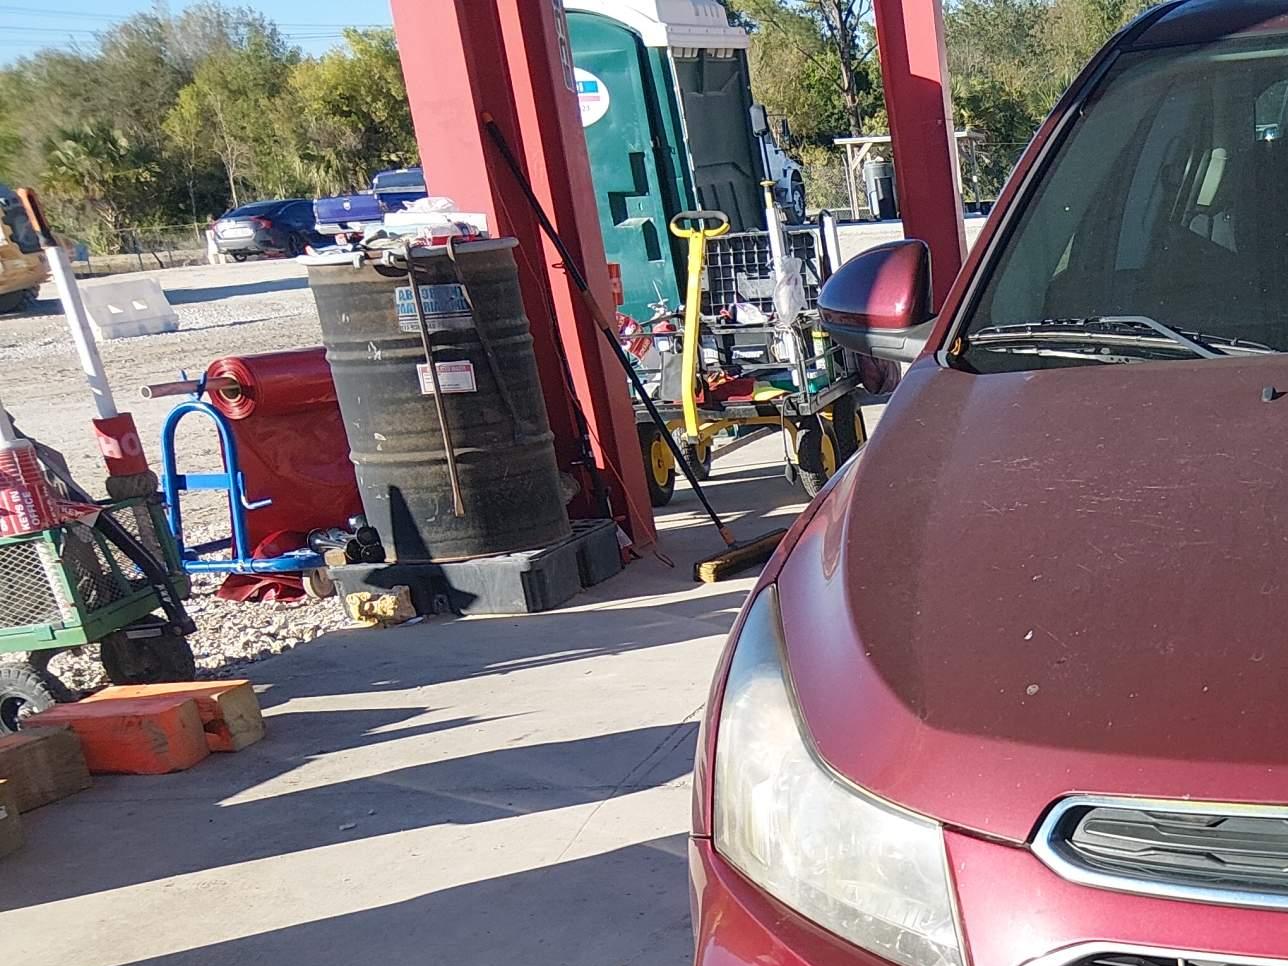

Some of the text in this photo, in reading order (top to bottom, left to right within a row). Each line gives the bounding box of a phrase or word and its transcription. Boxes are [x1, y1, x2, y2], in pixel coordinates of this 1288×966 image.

[9, 490, 31, 531] KEYS IN
[21, 491, 41, 526] OFFICE
